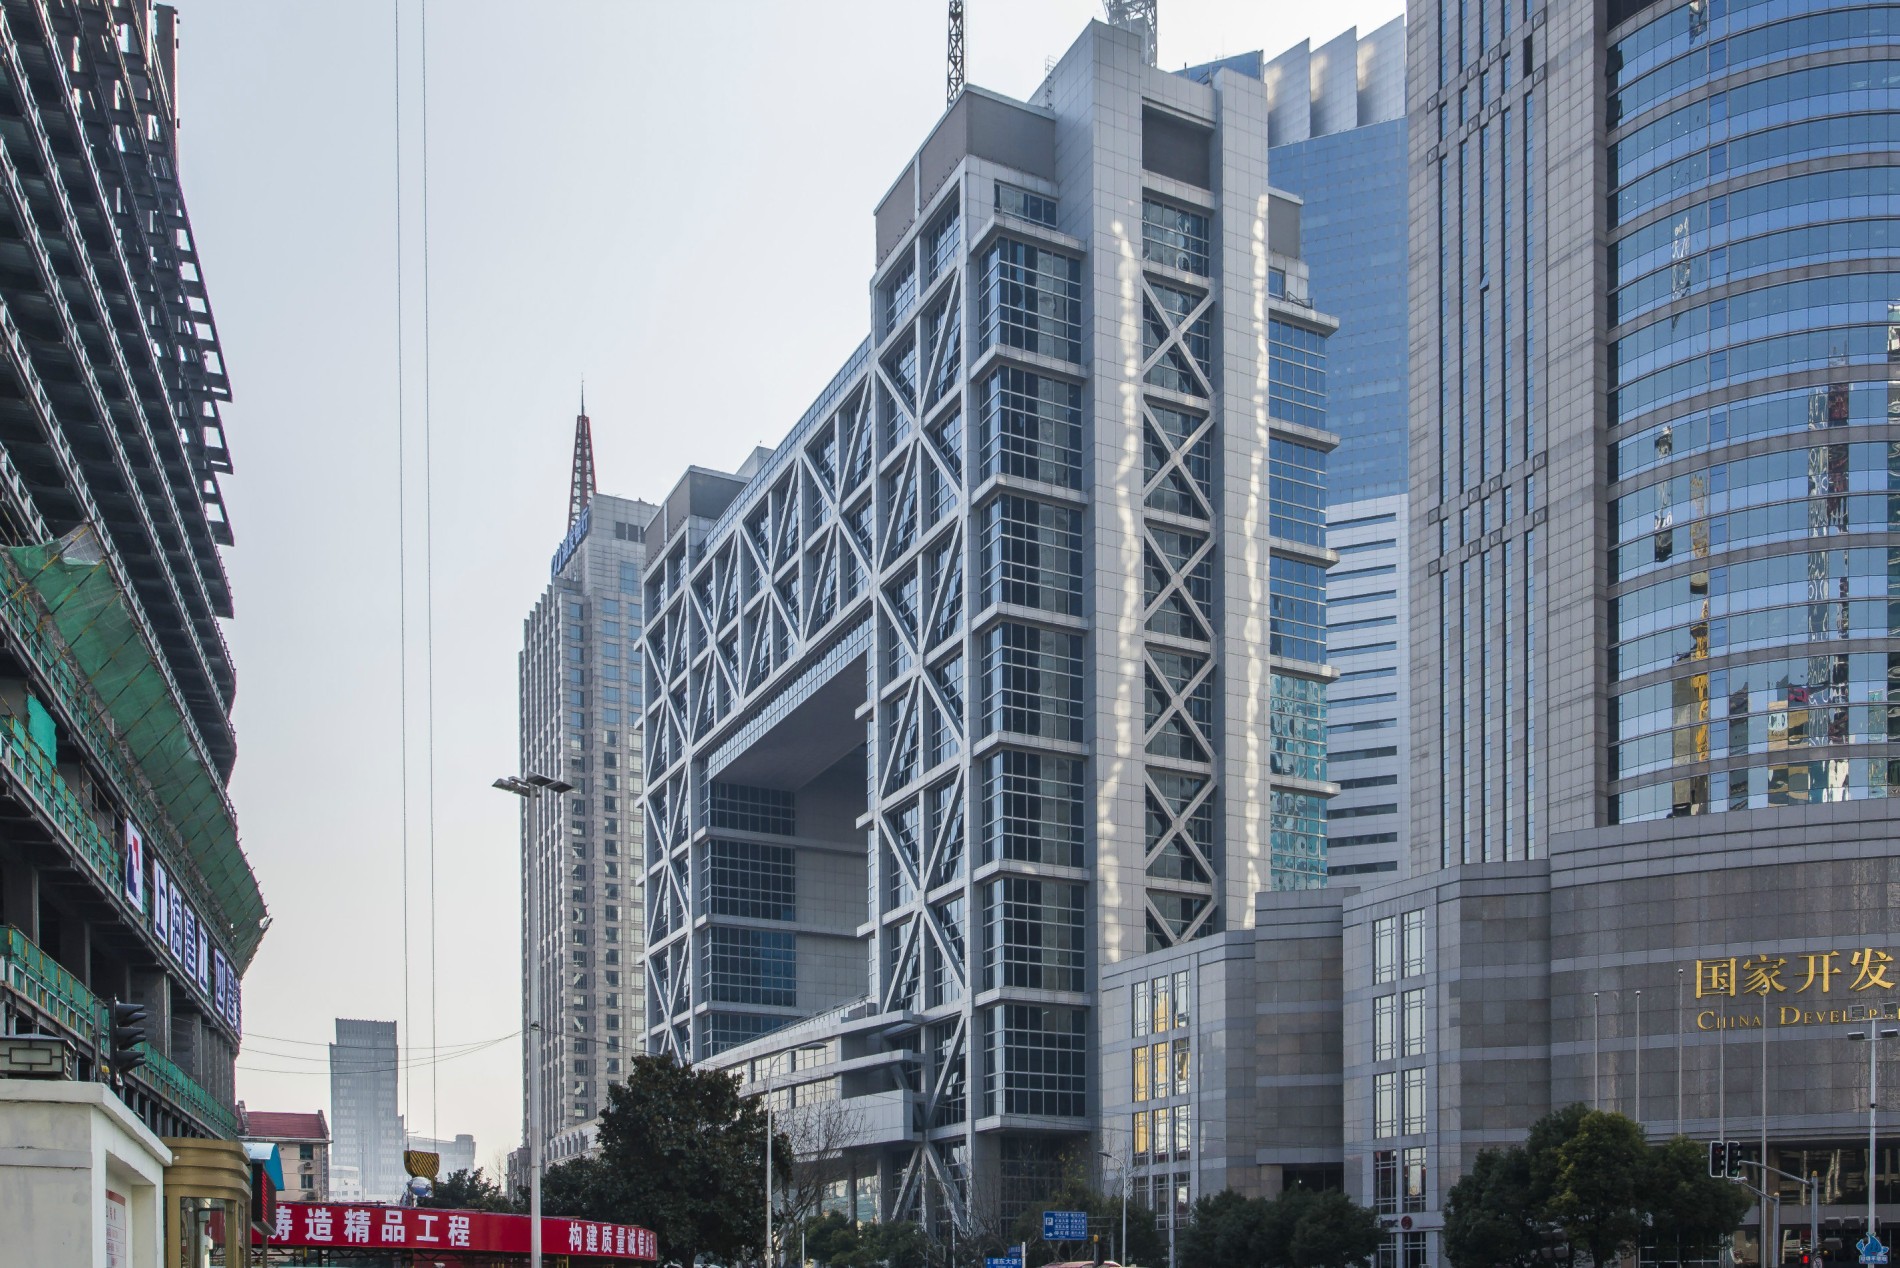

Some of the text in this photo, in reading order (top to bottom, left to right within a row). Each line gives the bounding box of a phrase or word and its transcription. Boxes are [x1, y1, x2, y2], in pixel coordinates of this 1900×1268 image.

[156, 866, 208, 994] 上海建工
[1695, 948, 1896, 999] 国家开发
[1697, 1006, 1900, 1030] CHINA DEVELP
